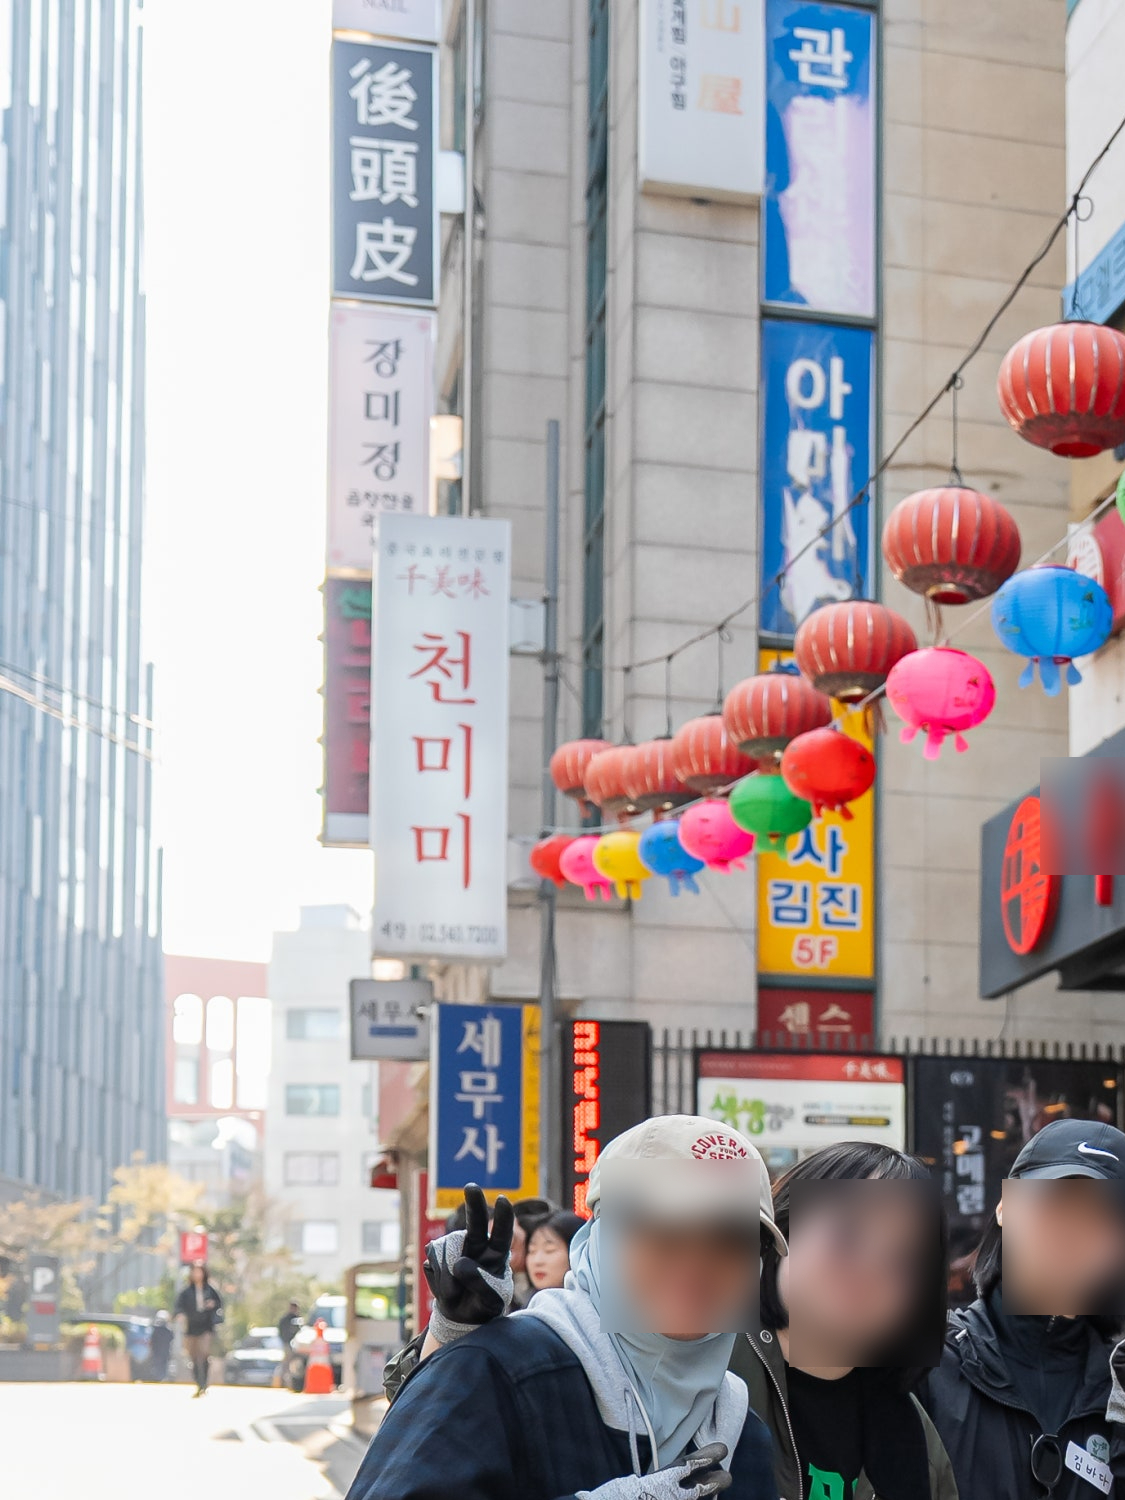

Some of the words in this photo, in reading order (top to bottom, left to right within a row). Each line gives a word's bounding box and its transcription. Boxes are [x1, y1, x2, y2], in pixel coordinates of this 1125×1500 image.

[348, 57, 419, 287] 後頭皮
[396, 562, 494, 600] 千美味
[408, 629, 478, 890] 천미미
[768, 881, 862, 929] 김진
[793, 937, 839, 969] 5F
[453, 1014, 505, 1175] 세무사
